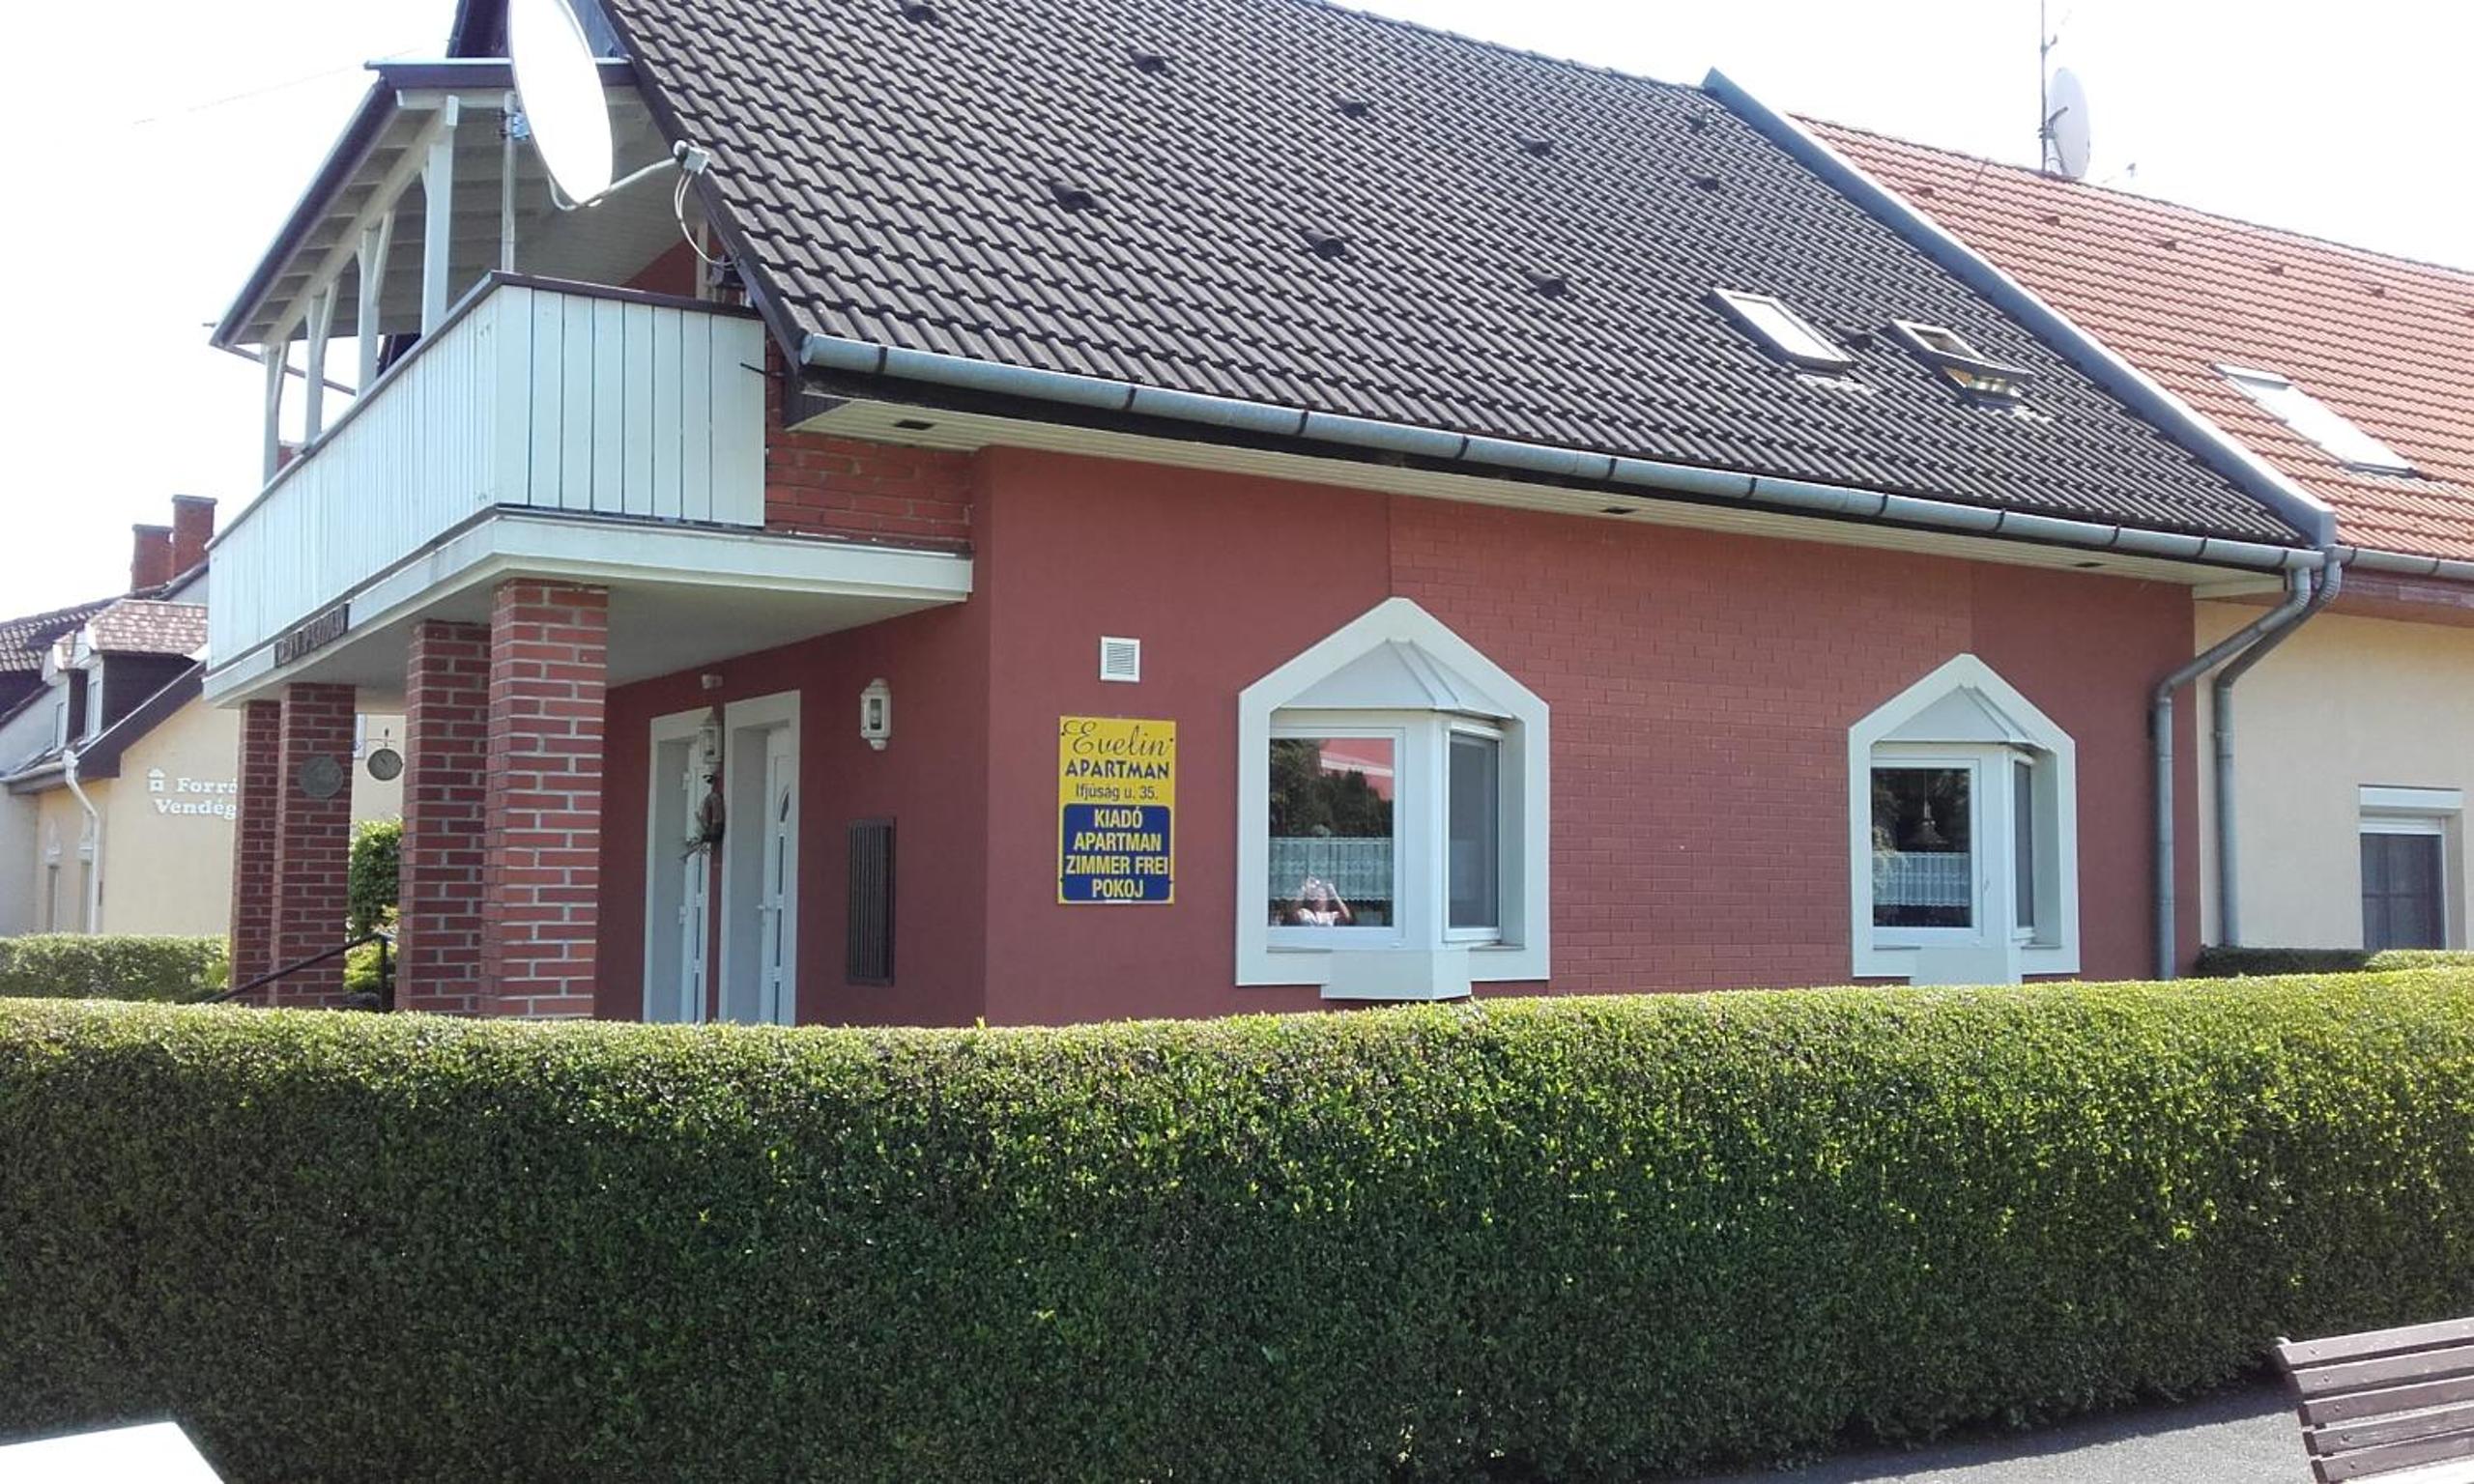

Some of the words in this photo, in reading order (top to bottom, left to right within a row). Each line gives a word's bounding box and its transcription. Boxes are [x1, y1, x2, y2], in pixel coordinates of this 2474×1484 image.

[1063, 720, 1167, 756] Evelin
[1065, 758, 1169, 779] APARTMAN
[1094, 807, 1142, 828] KIADÓ
[1074, 832, 1162, 851] APARTMAN
[1065, 855, 1131, 874] ZIMMER
[1136, 856, 1168, 874] FREI
[1092, 878, 1143, 899] POKOJ
